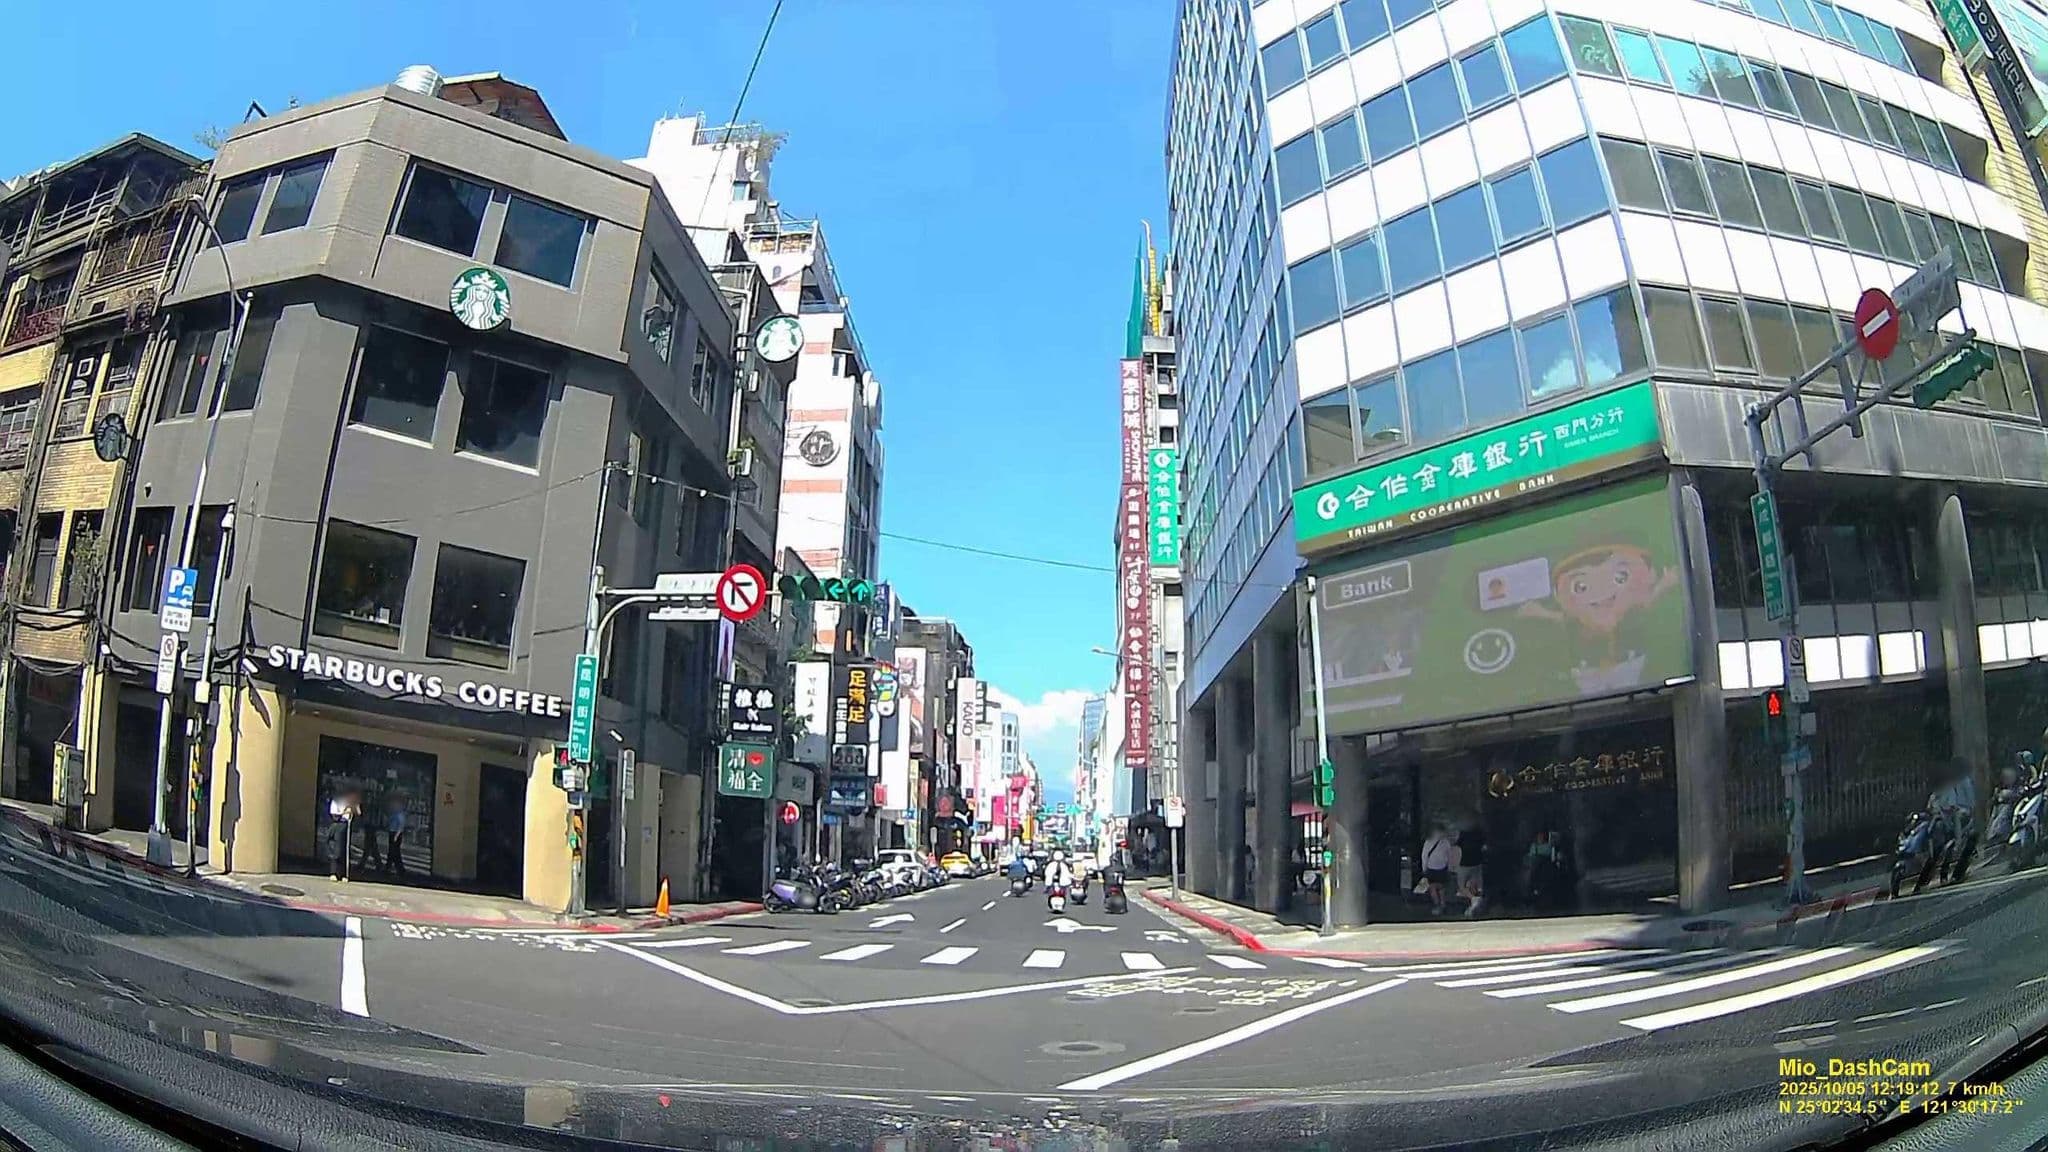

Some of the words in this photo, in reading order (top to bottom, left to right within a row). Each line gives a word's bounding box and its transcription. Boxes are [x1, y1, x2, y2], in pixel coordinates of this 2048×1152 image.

[1344, 430, 1548, 510] 合作金庫銀行
[1553, 405, 1625, 441] 西門分行
[1347, 518, 1394, 539] TAIWAN
[1409, 489, 1501, 523] COOPERATIVE
[1518, 473, 1555, 492] BANK
[1340, 575, 1394, 600] Bank
[268, 645, 444, 698] STARBUCKS
[458, 681, 562, 717] COFFEE
[848, 670, 867, 723] 足滿足
[962, 702, 974, 737] KAKO
[728, 770, 763, 792] 福全
